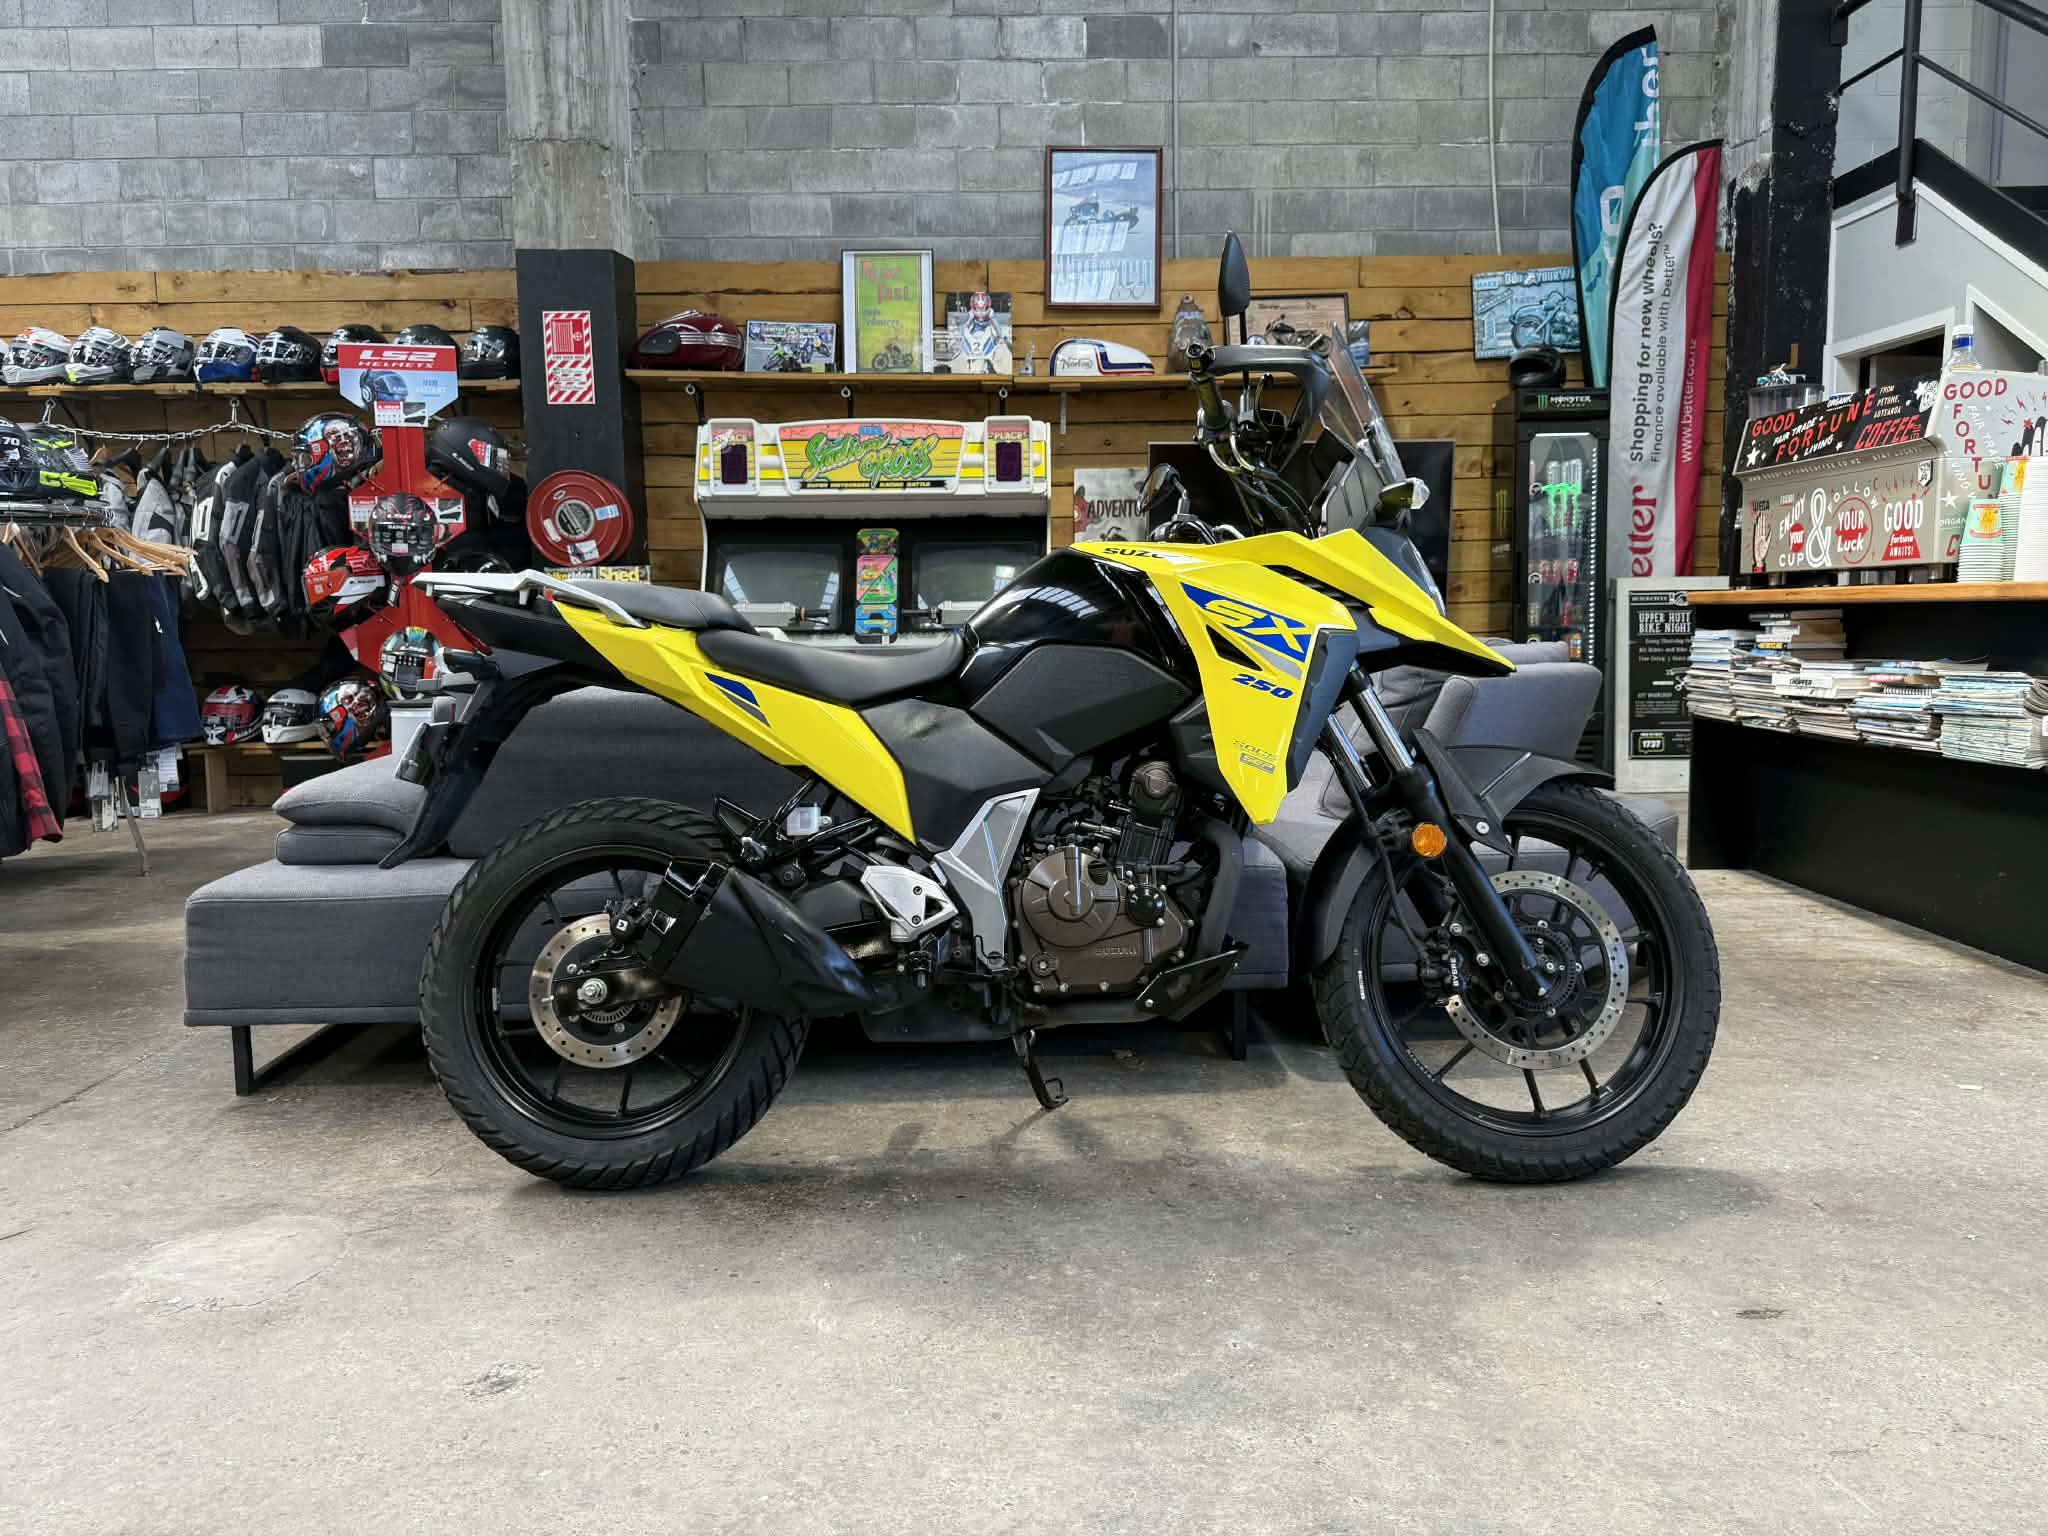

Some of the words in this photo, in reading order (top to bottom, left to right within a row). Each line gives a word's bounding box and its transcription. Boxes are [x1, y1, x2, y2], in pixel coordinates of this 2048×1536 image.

[1642, 222, 1663, 296] wheels?
[1641, 299, 1654, 339] new
[1658, 302, 1670, 332] with
[358, 361, 434, 369] HELMETS
[360, 350, 437, 362] LS2
[1637, 342, 1651, 368] for
[1655, 335, 1667, 402] available
[1680, 337, 1697, 464] www.better.co.nz
[1879, 384, 1895, 394] FROM
[1943, 378, 2008, 400] GOOD
[1630, 372, 1653, 462] Shopping
[1753, 412, 1797, 437] GOOD
[1967, 405, 1985, 431] FAIR
[1651, 407, 1664, 462] Finance
[1772, 430, 1790, 446] FAIR
[1791, 416, 1817, 435] TRADE
[1855, 415, 1920, 449] COFFEE
[1803, 433, 1834, 456] LIVING
[1827, 481, 1879, 514] FOLLOW
[1779, 493, 1805, 540] ENJOY
[1805, 488, 1833, 568] &
[1838, 510, 1864, 531] YOUR
[1883, 499, 1924, 533] GOOD
[1837, 532, 1864, 553] Luck
[1889, 534, 1914, 546] fortune
[1889, 546, 1914, 557] AWAITS!
[1778, 553, 1805, 567] CUP
[600, 566, 640, 583] Shed
[1205, 600, 1304, 654] SX
[1639, 612, 1665, 623] UPPER
[1668, 612, 1691, 623] HUTT
[1639, 622, 1662, 633] BIKE
[1664, 622, 1691, 633] NIGHT
[1232, 673, 1294, 699] 250
[1641, 739, 1662, 749] 1737
